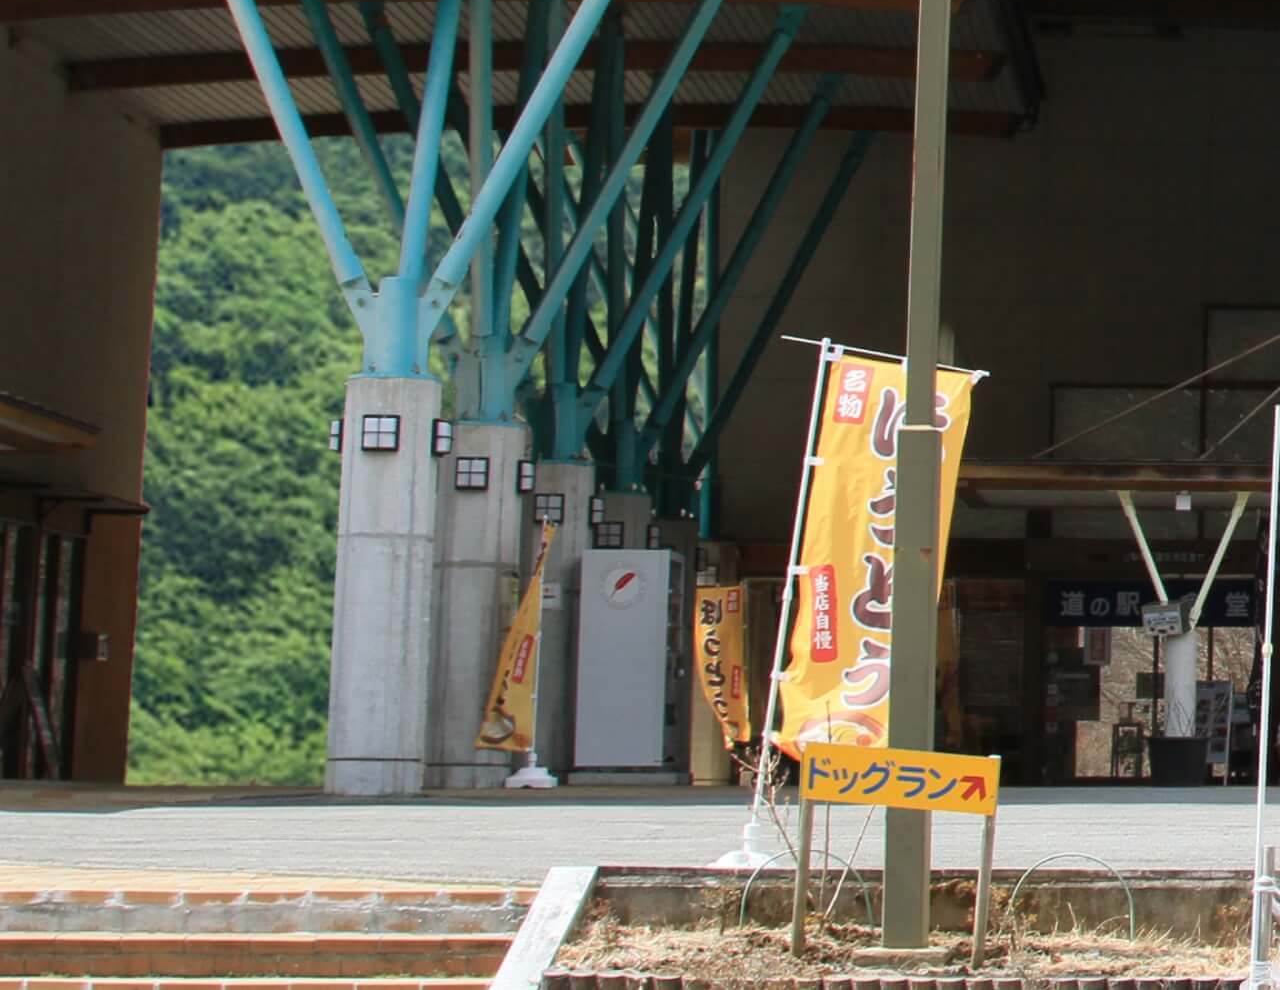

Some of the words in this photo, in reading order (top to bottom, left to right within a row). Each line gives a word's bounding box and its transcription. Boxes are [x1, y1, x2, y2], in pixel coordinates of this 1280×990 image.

[839, 369, 867, 420] 名物
[813, 573, 834, 651] 当店自慢
[1060, 591, 1140, 617] 道の駅
[807, 757, 957, 799] ドッグラン
